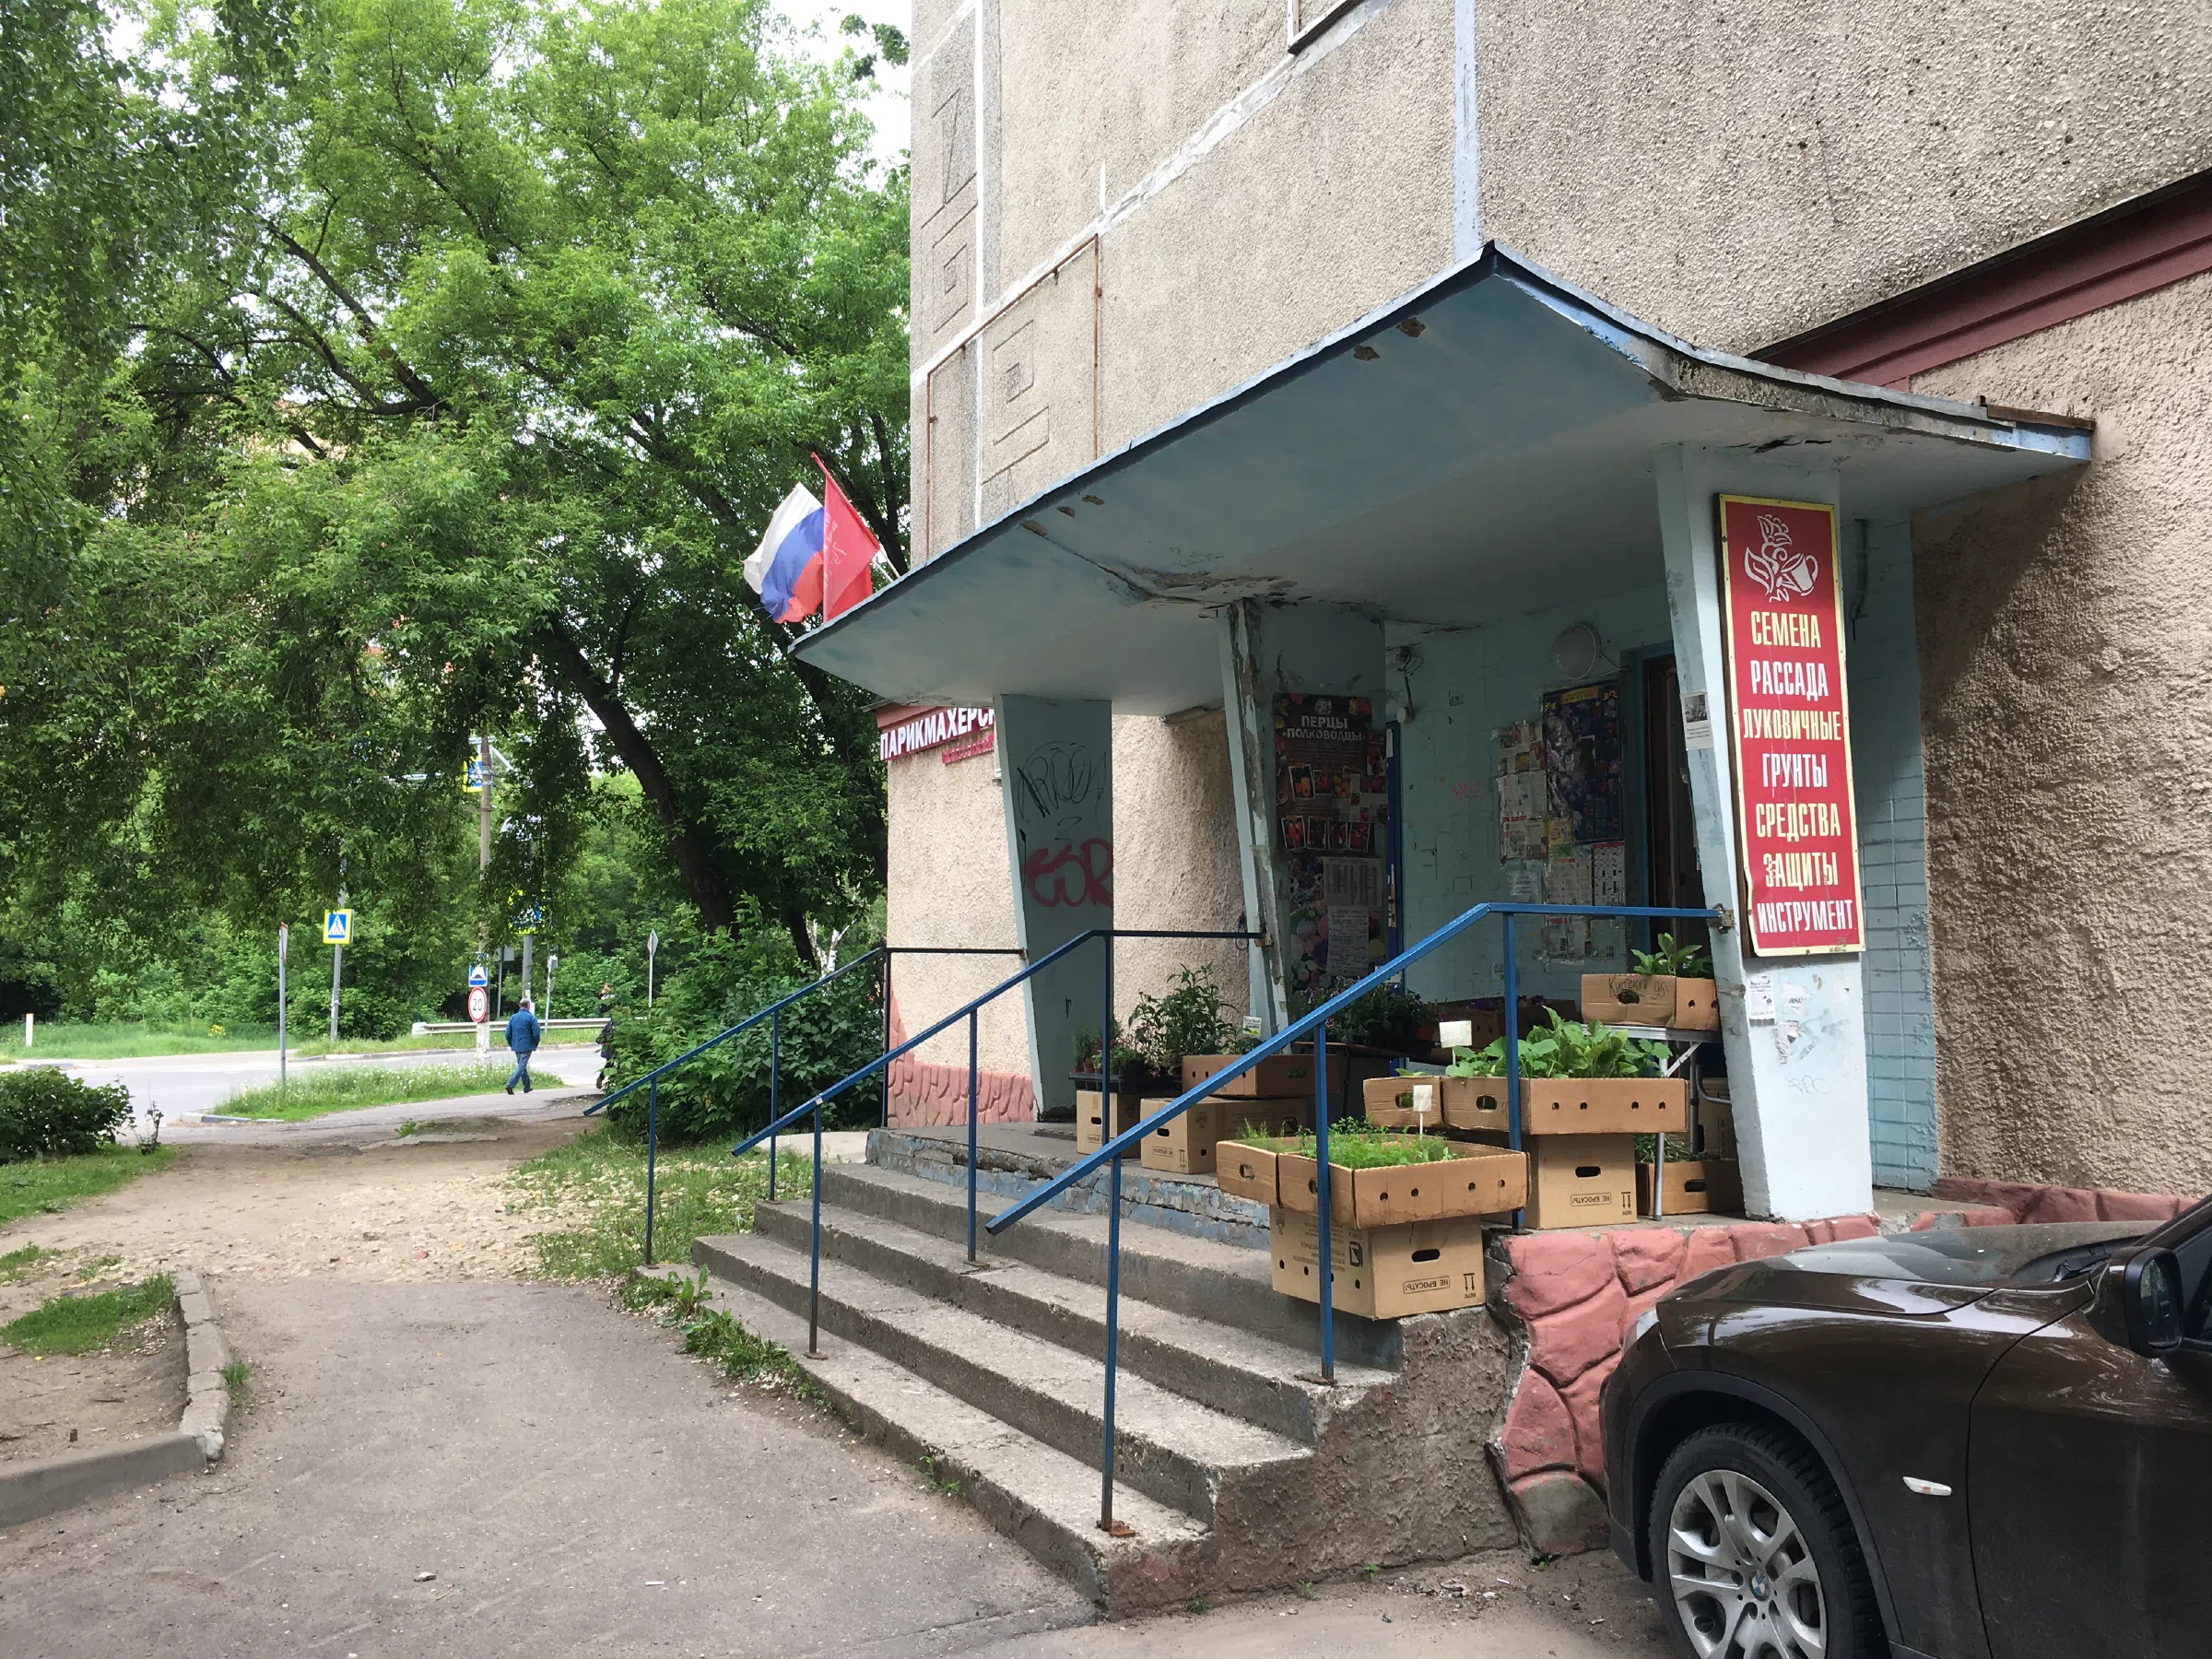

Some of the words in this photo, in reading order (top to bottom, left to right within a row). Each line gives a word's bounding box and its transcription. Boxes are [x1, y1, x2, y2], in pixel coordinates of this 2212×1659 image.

[1750, 610, 1821, 649] СЕМЕНА
[1750, 659, 1830, 701] РАССАДА
[1300, 715, 1348, 729] ПЕРЦЫ
[1744, 708, 1841, 741] ЛУКОВИЧНЫЕ
[1761, 753, 1828, 789] ГРУНТЫ
[1756, 803, 1841, 841] СРЕДСТВА
[1763, 851, 1839, 893] ЗАЩИТЫ
[1757, 899, 1853, 935] ИНСТРУМЕНТ
[473, 998, 482, 1011] 20
[1404, 1279, 1438, 1292] БРОСАТЬ!
[1440, 1277, 1449, 1287] НЕ
